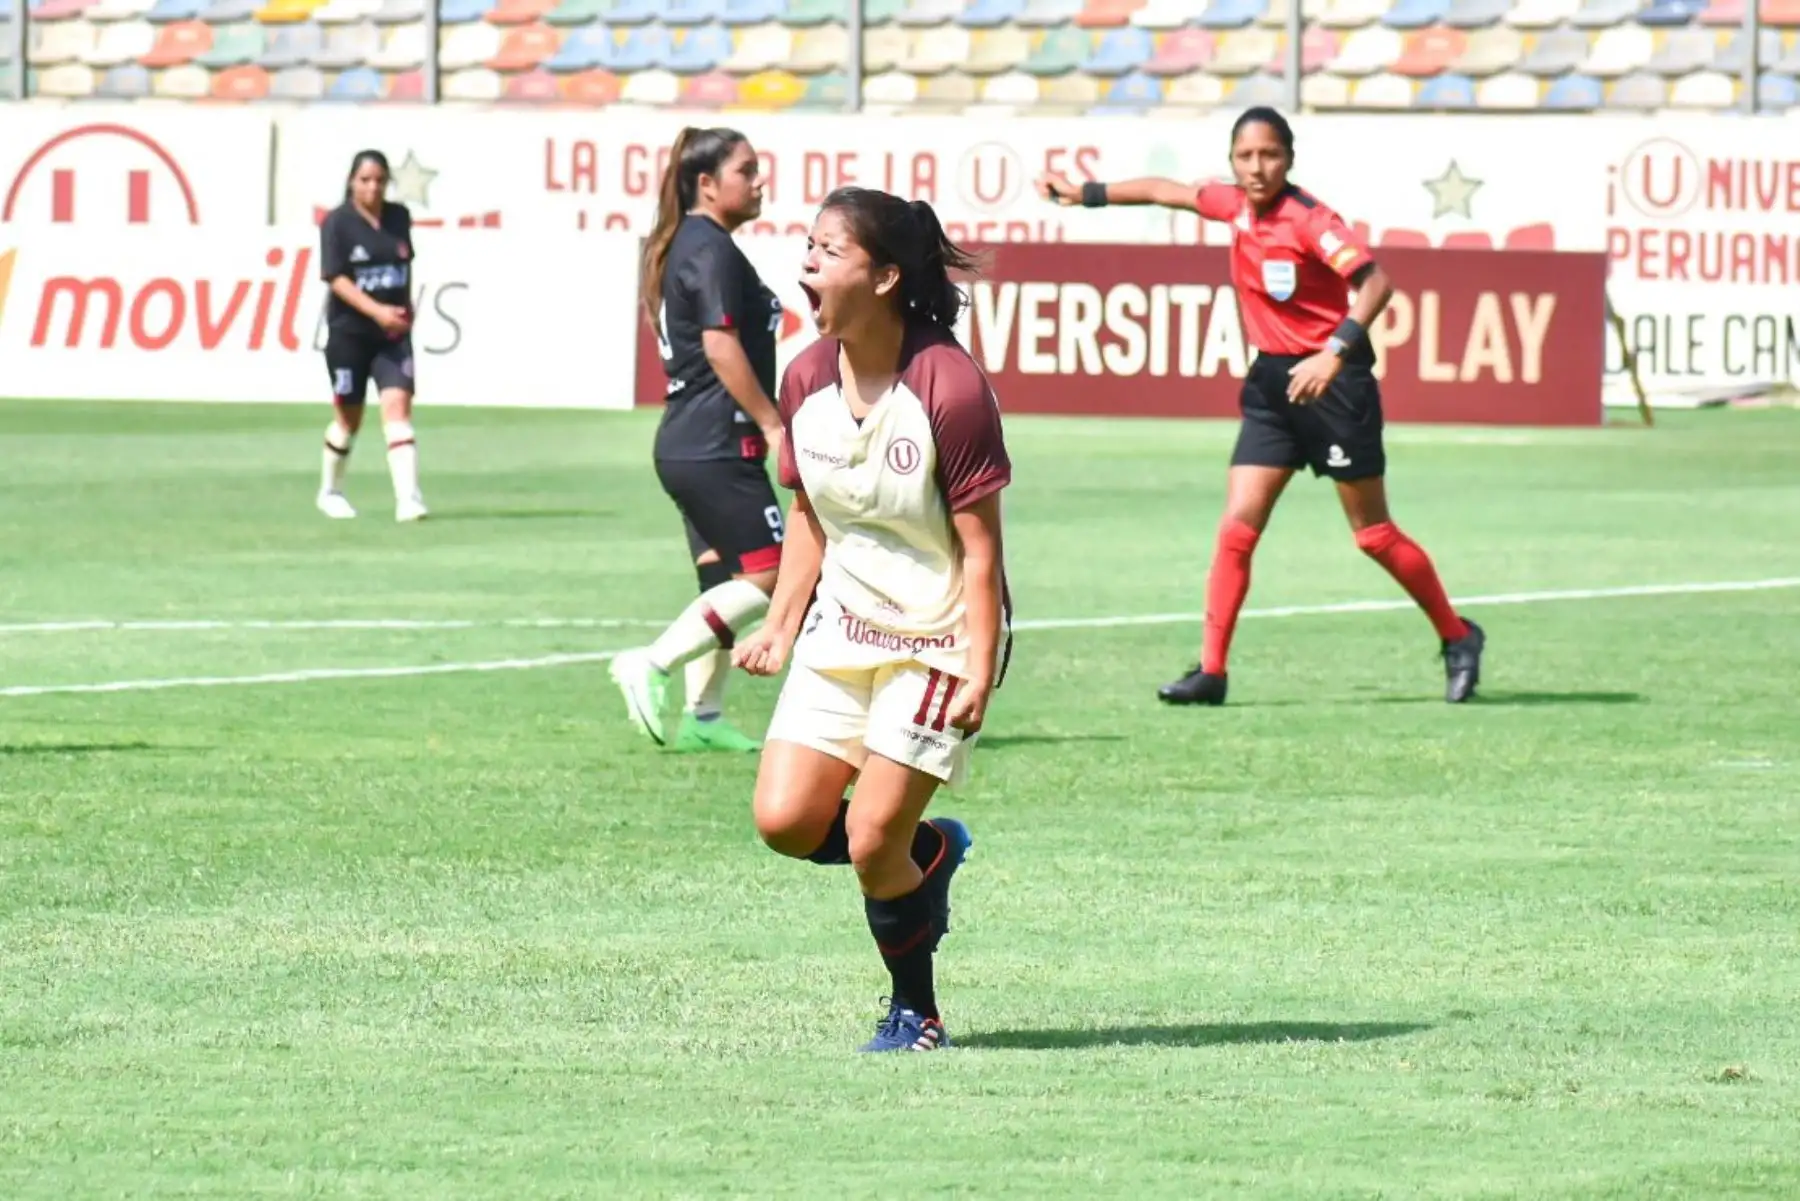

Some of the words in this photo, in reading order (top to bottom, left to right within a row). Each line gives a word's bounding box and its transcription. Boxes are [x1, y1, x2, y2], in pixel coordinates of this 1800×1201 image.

[545, 137, 597, 193] LA
[802, 151, 860, 204] DE
[972, 155, 1008, 204] U
[1605, 226, 1800, 285] PERUAN
[950, 281, 1259, 378] IVERSITA
[1369, 289, 1557, 384] PLAY
[764, 505, 784, 543] 9
[912, 666, 960, 733] 11
